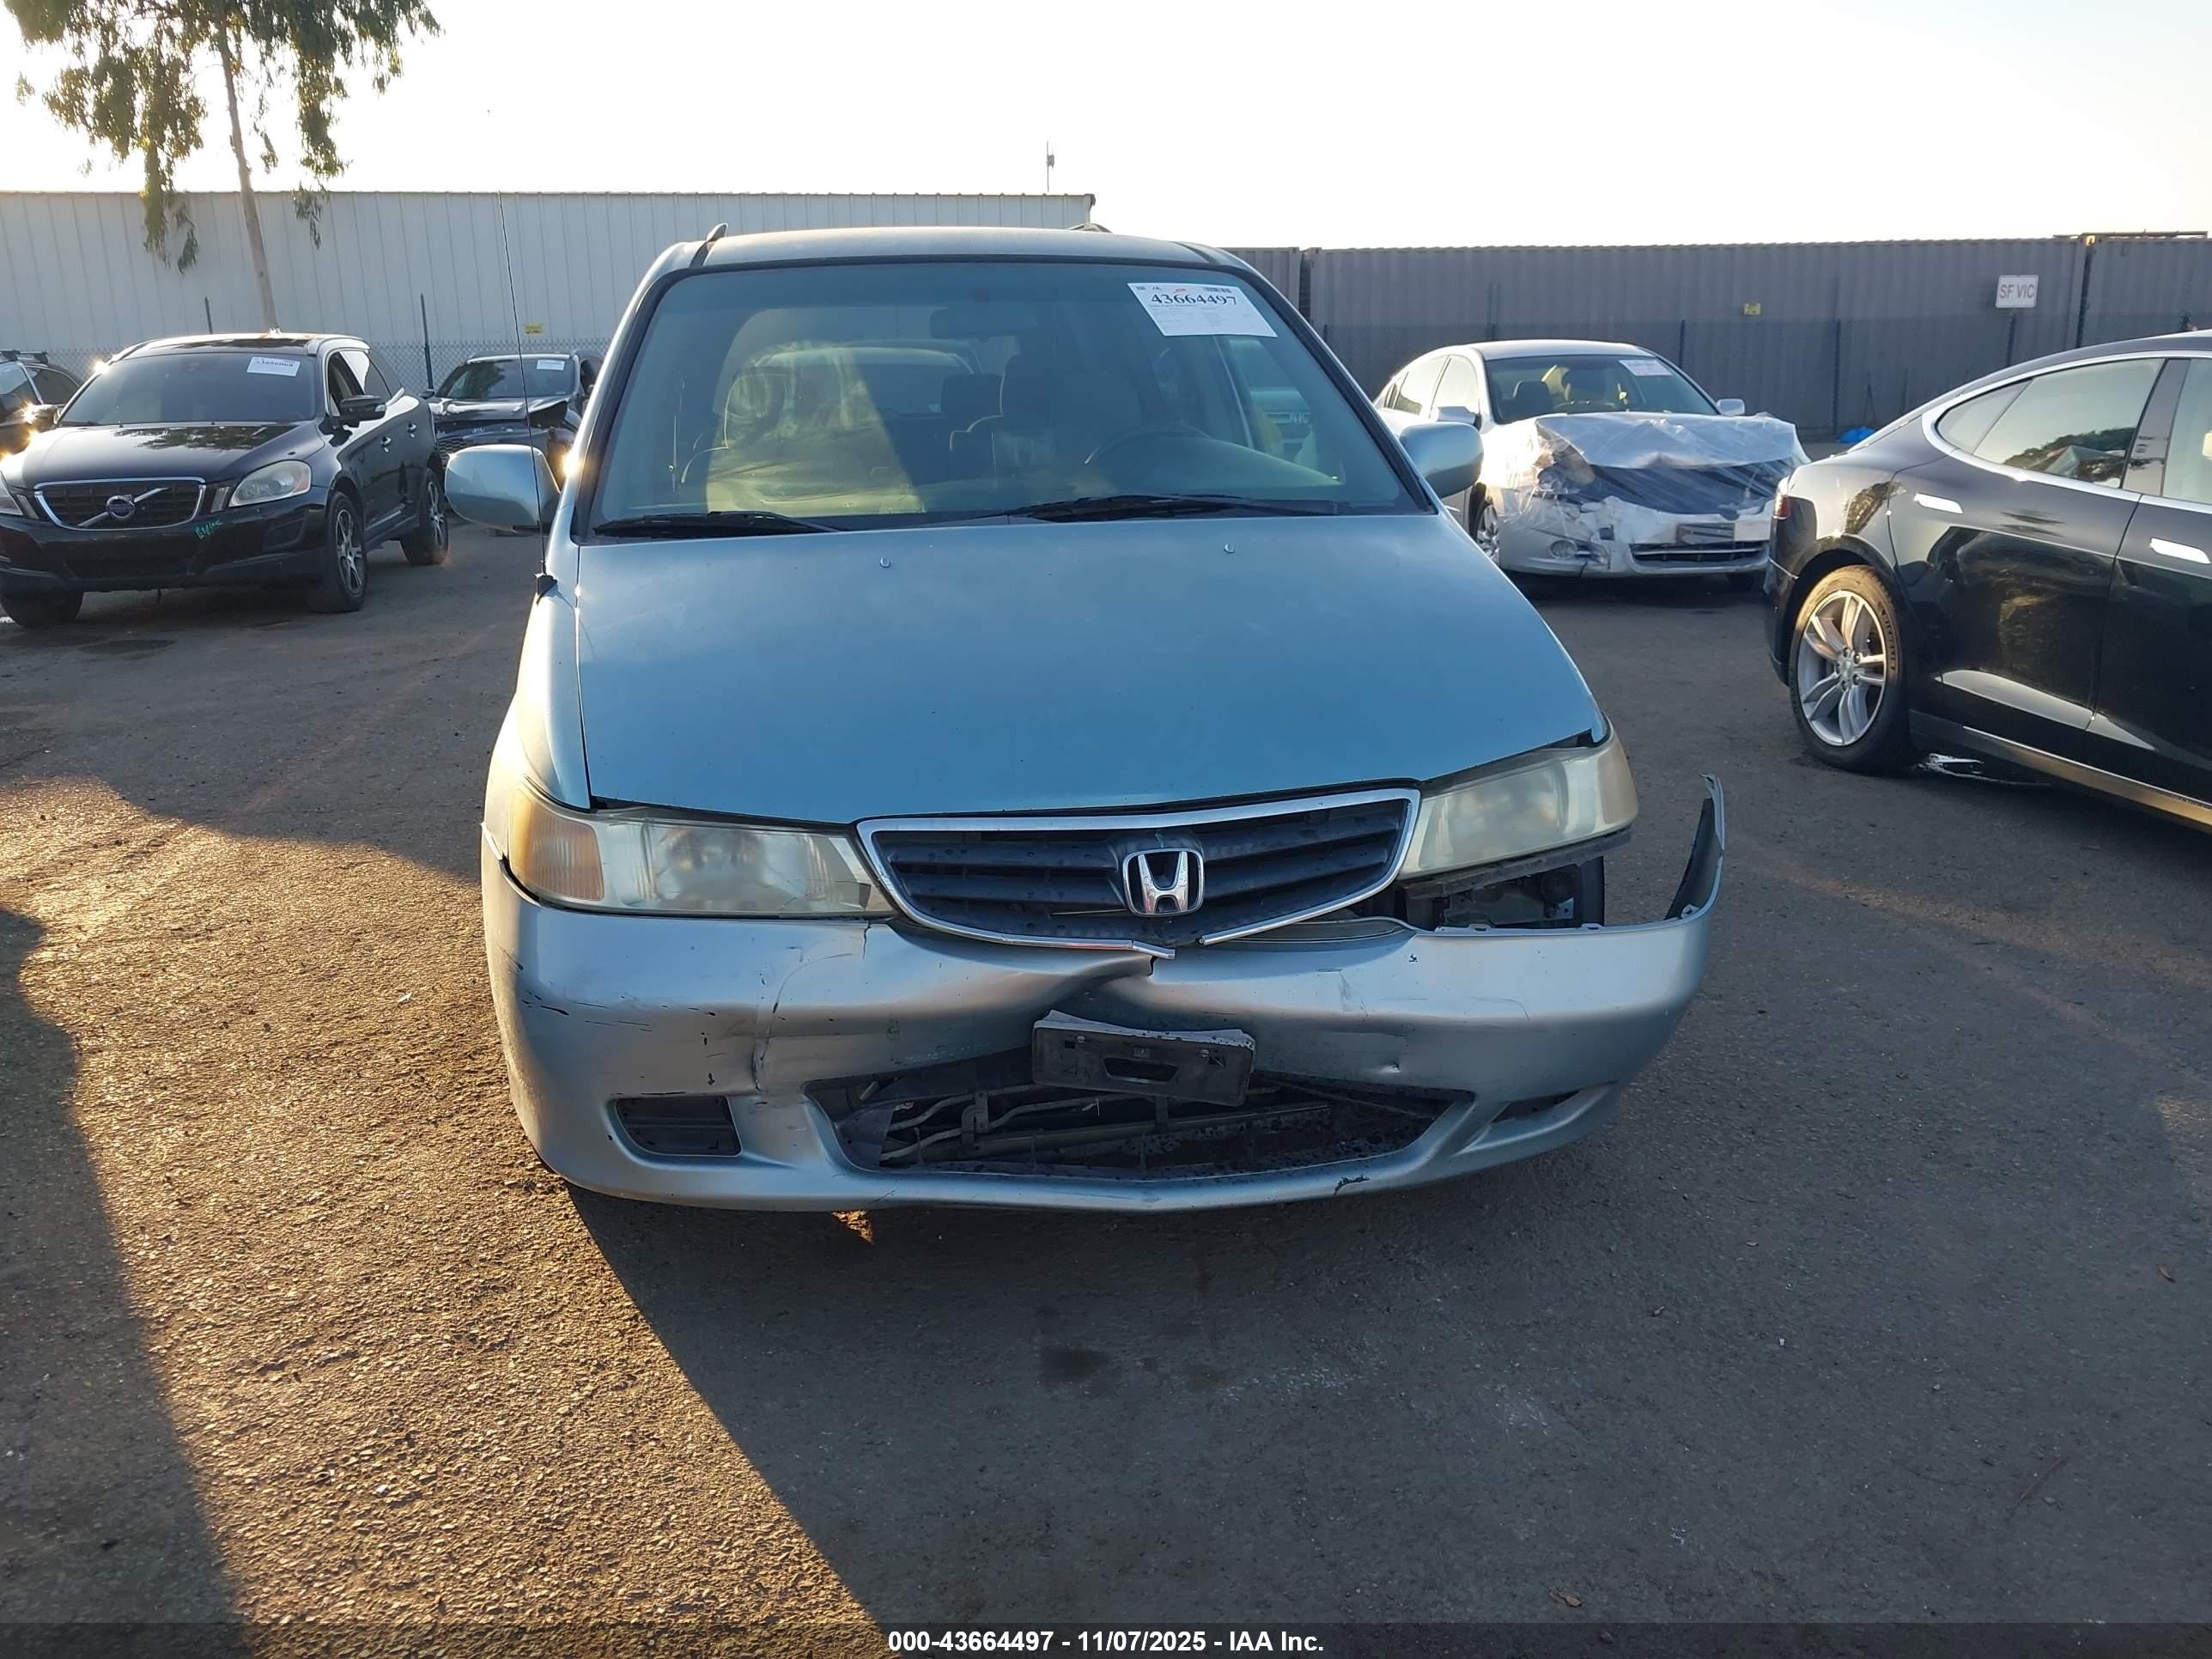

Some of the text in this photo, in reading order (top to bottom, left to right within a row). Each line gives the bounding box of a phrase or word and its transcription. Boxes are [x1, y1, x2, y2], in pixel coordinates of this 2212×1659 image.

[1999, 284, 2035, 299] SF VIC
[1151, 294, 1237, 306] 43664497
